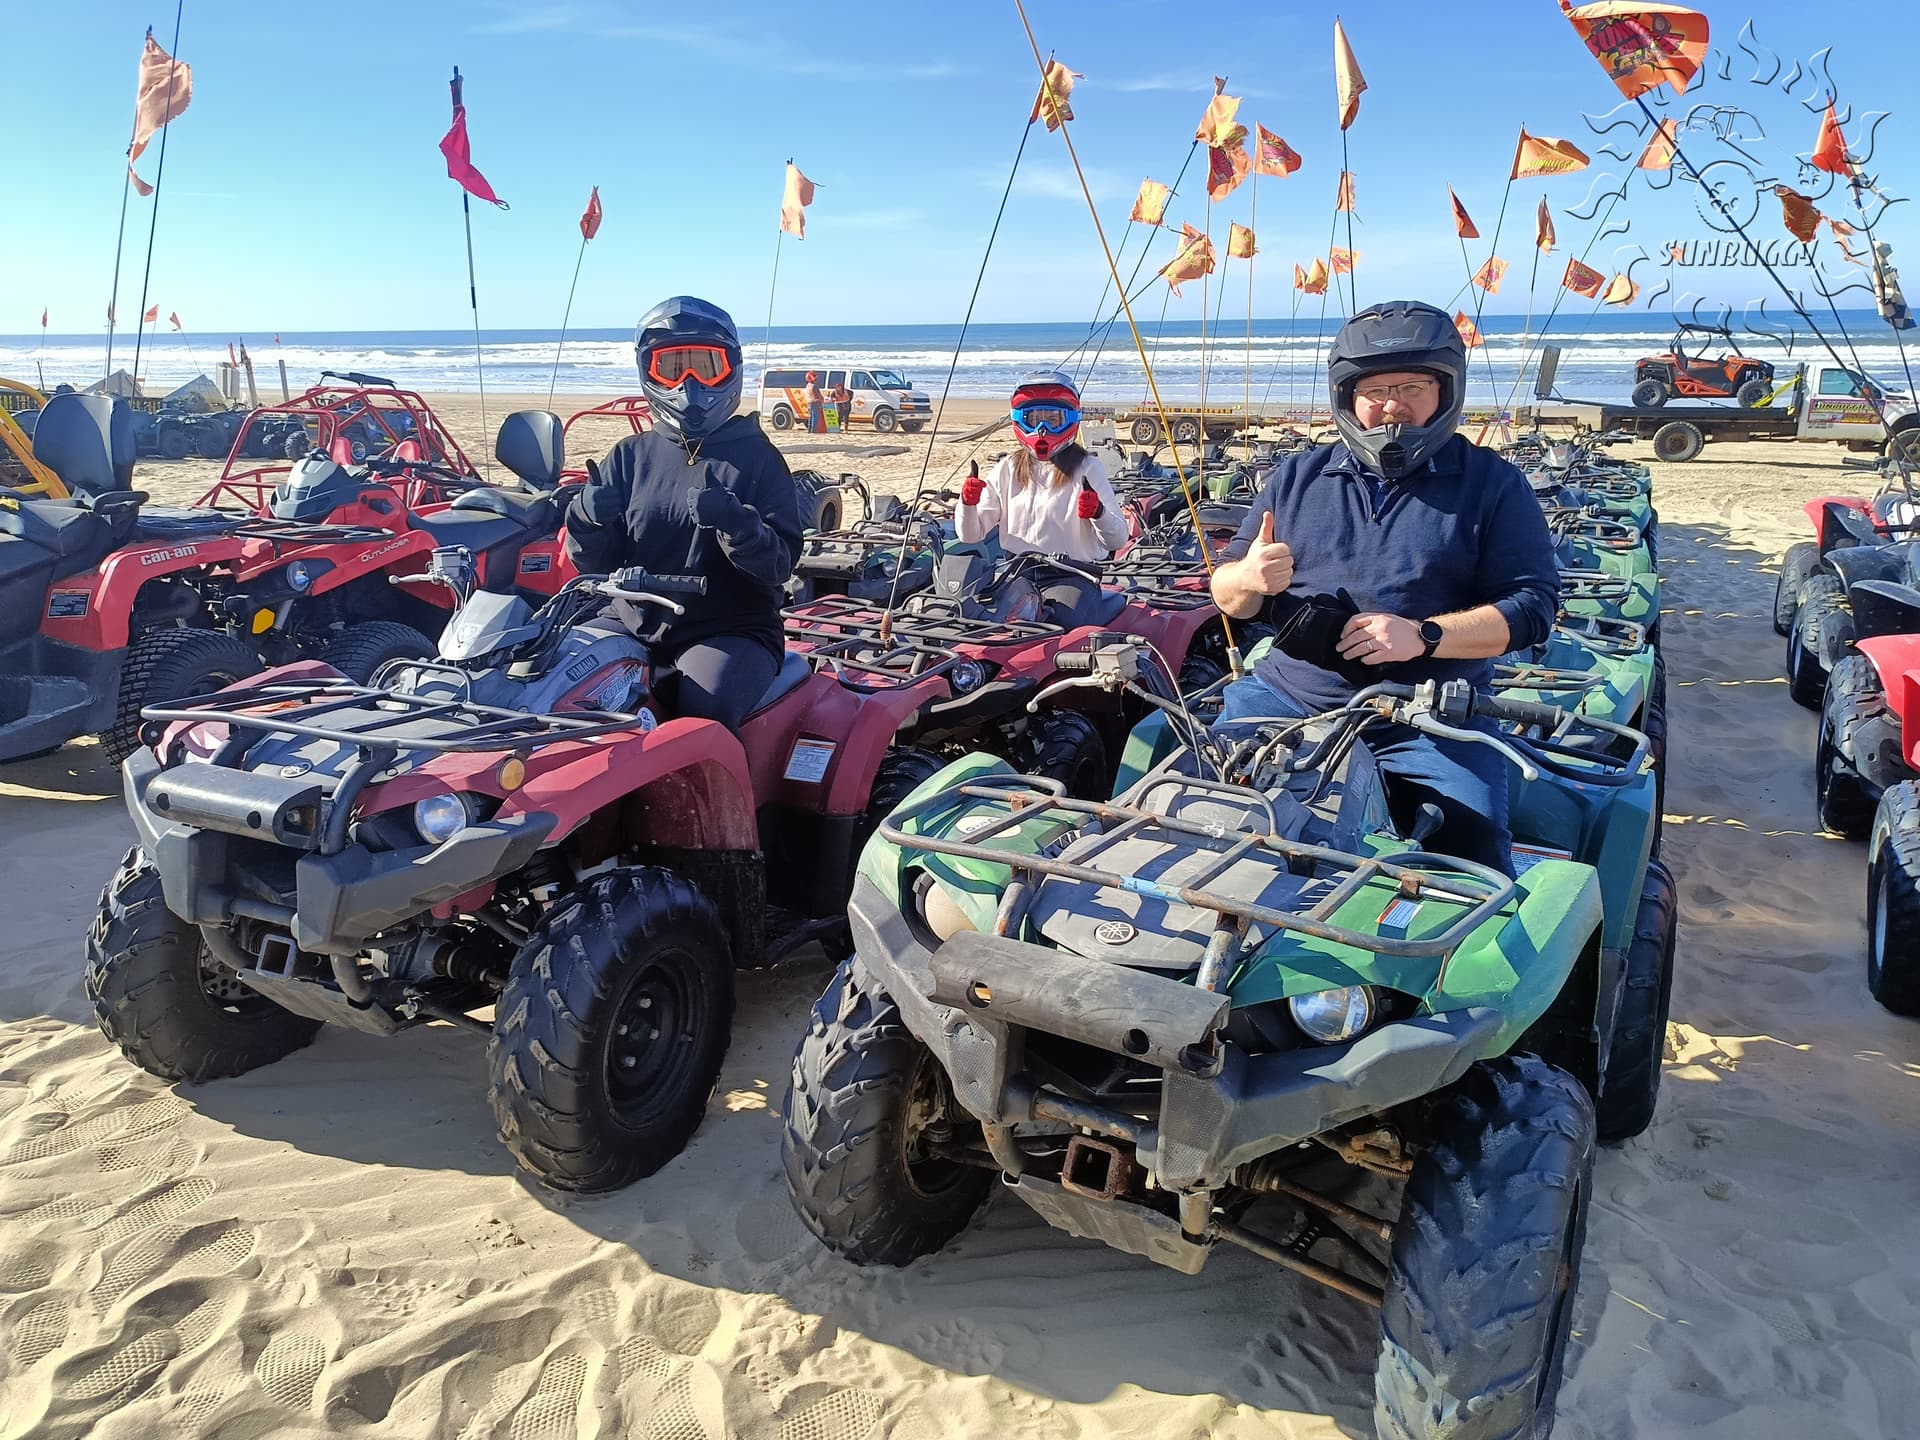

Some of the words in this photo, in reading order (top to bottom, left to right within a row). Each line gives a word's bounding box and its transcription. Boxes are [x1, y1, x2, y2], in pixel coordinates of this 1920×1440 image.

[140, 545, 197, 566] can-am
[361, 538, 409, 563] OUTLANDER
[567, 655, 598, 680] YAMAHA
